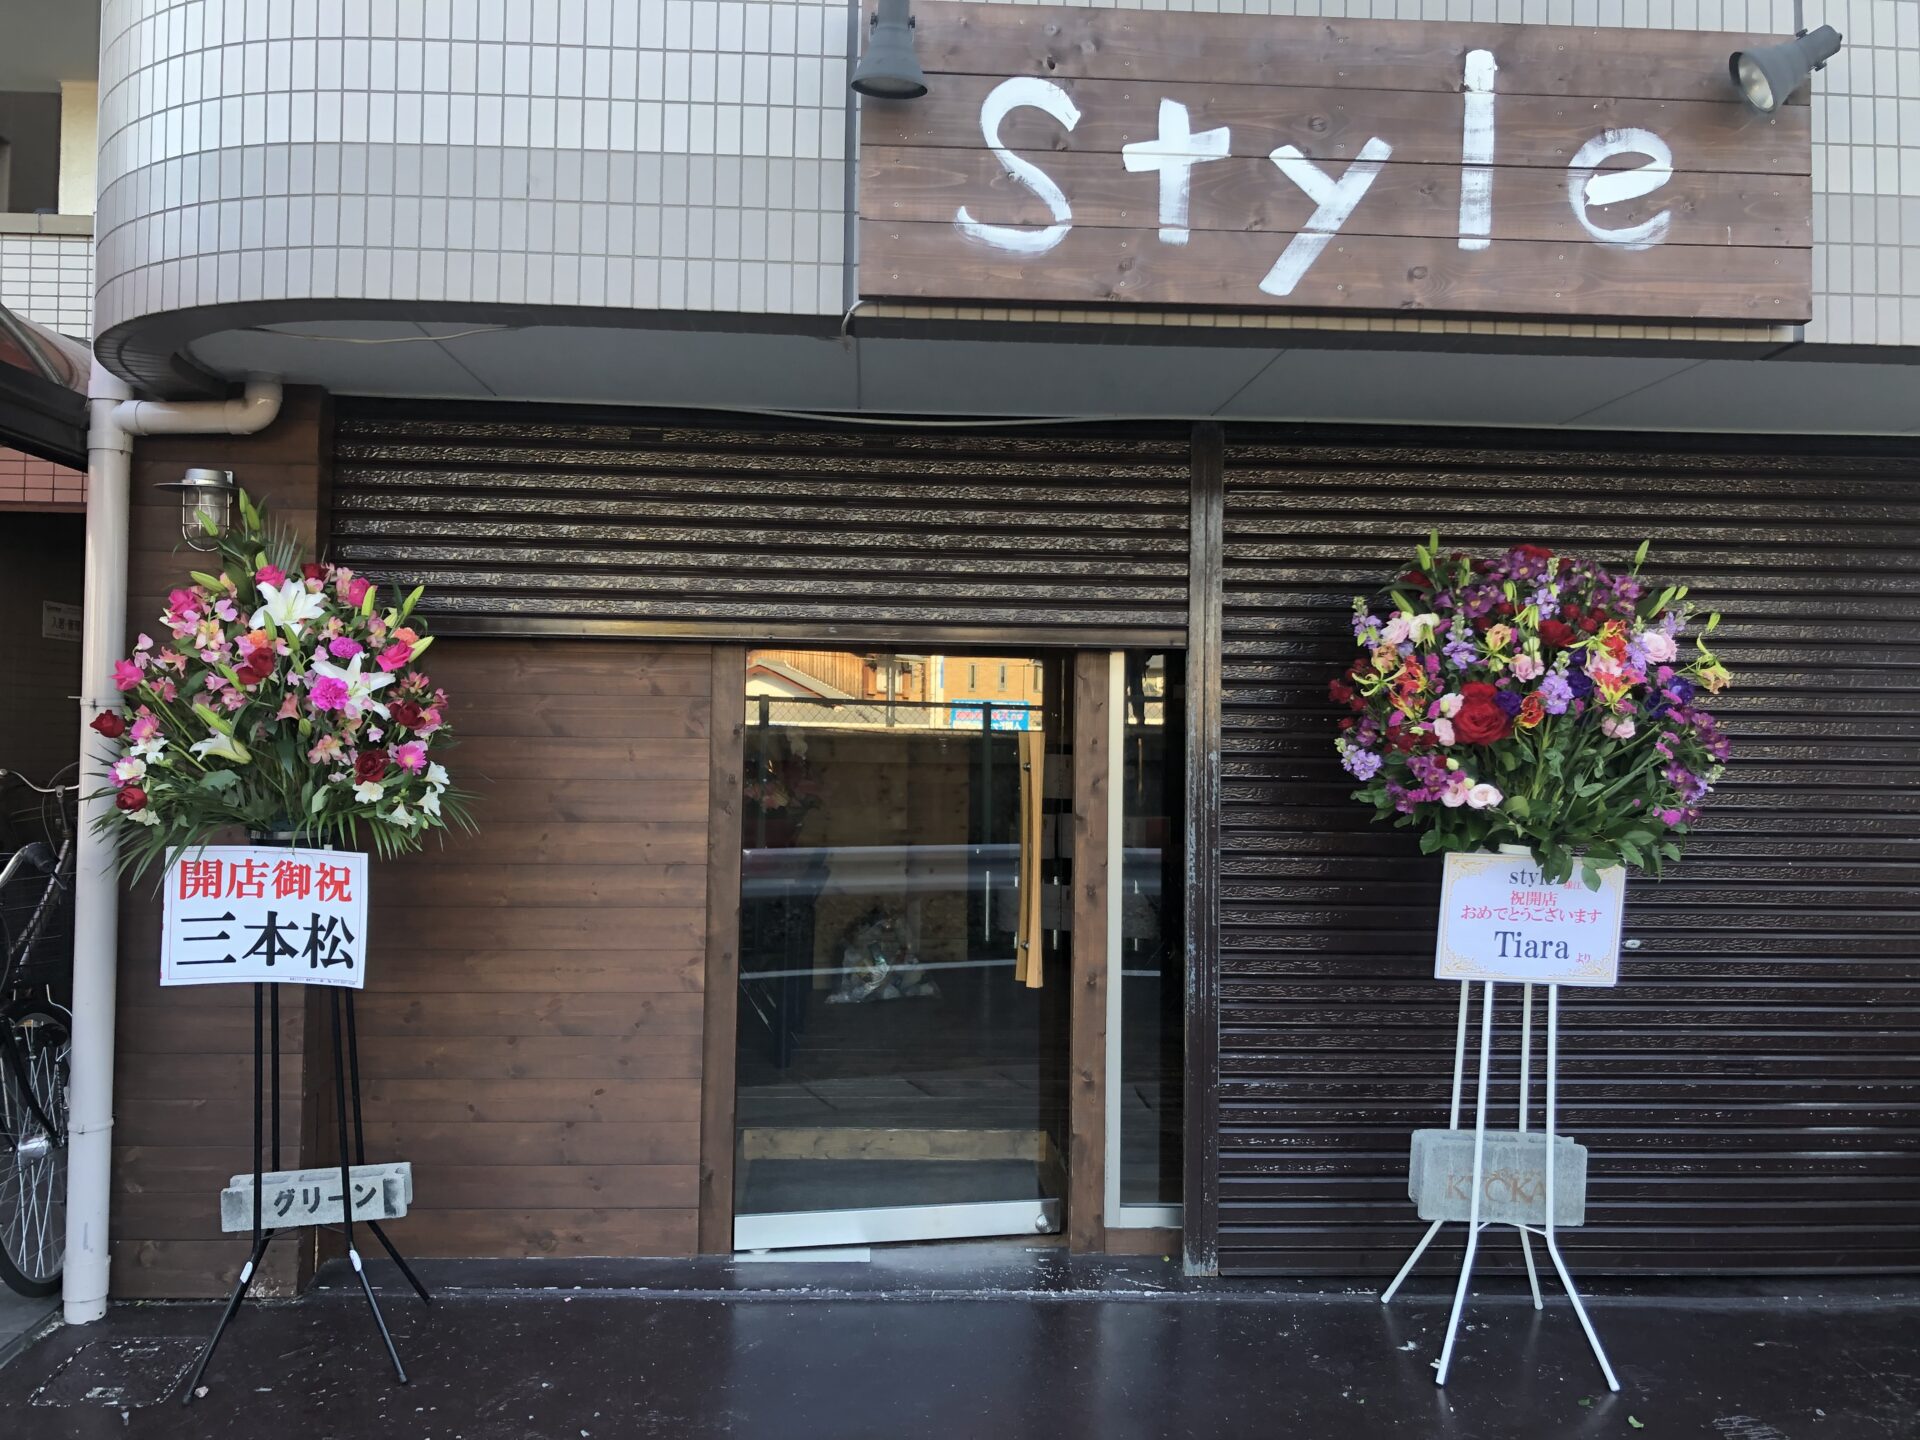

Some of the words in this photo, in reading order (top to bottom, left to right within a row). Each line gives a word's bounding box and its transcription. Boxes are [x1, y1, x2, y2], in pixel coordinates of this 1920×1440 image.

[955, 49, 1674, 297] Style
[179, 858, 353, 902] 開店御祝
[1460, 905, 1602, 924] おめでとうございます
[1510, 890, 1558, 906] 祝開店
[176, 911, 355, 969] 三本松
[1494, 931, 1570, 960] Tiara
[1576, 952, 1591, 965] より
[273, 1183, 377, 1217] グリーン
